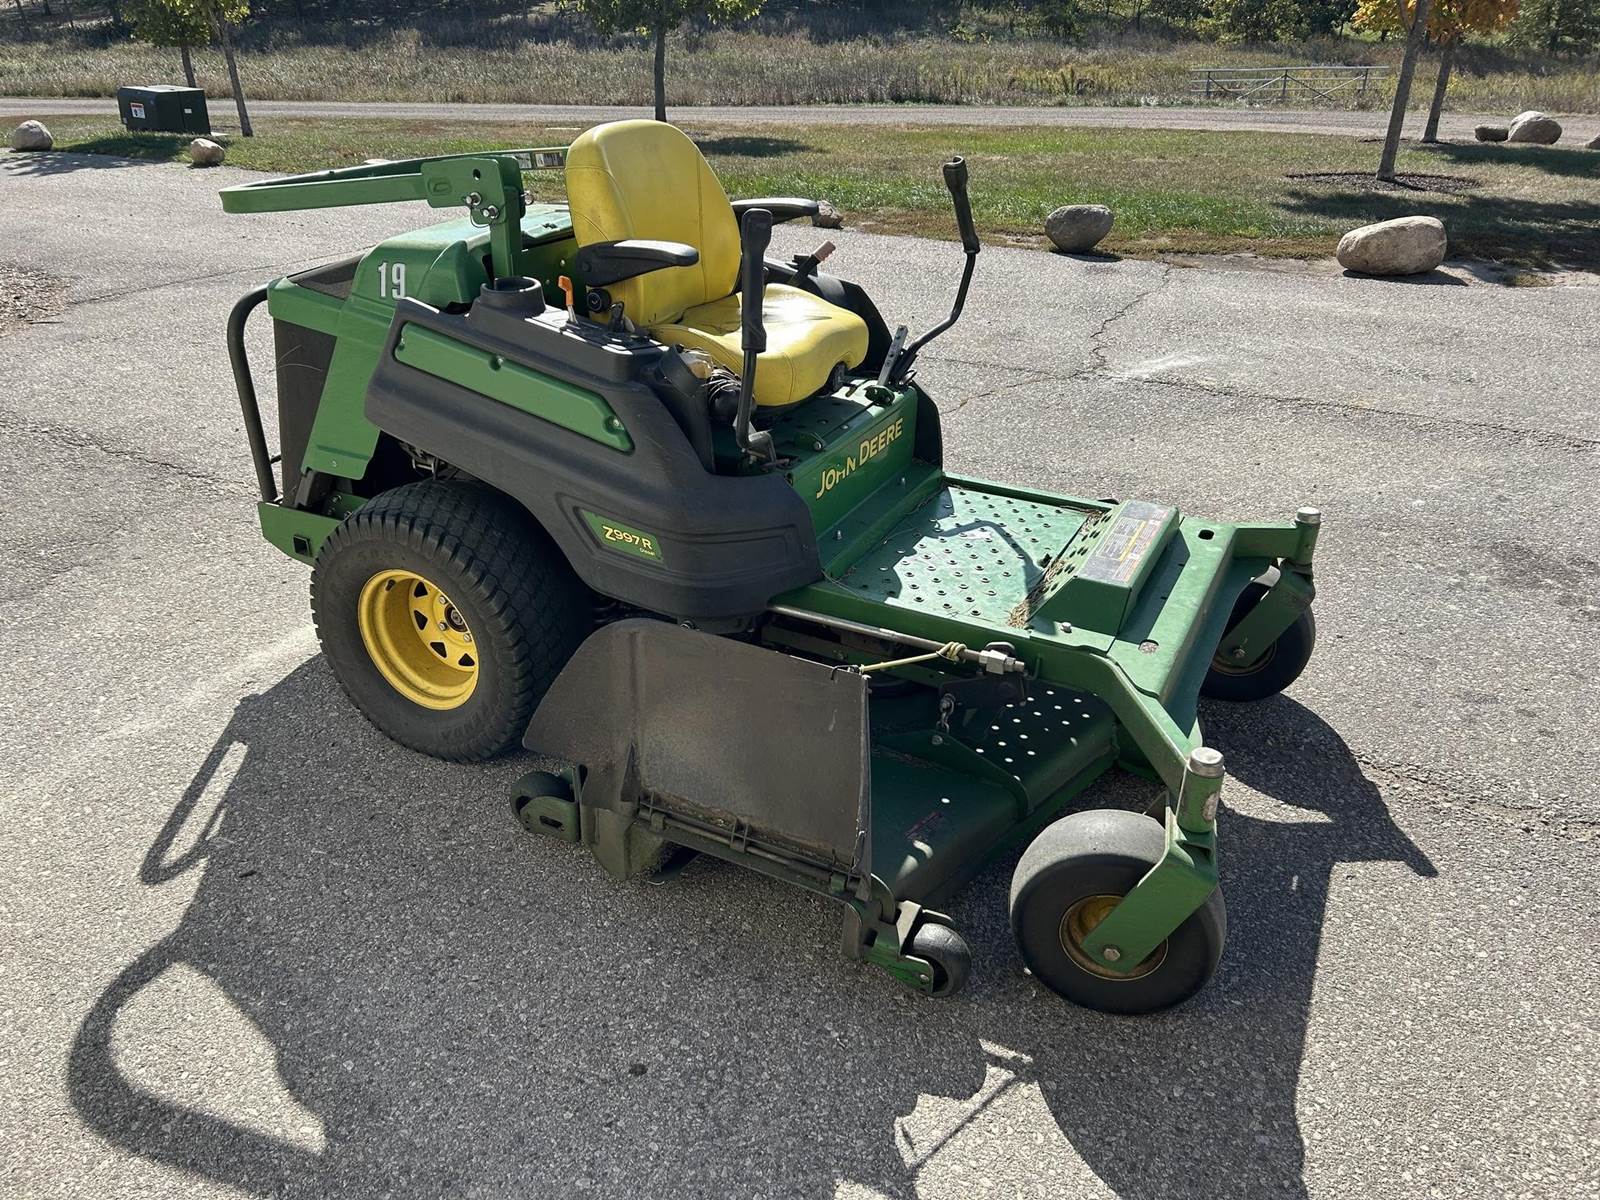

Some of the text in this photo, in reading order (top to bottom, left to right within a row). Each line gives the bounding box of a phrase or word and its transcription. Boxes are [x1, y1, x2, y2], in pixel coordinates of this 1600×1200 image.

[377, 262, 406, 300] 19
[816, 417, 904, 499] JOHN DEERE
[602, 525, 653, 550] Z997R
